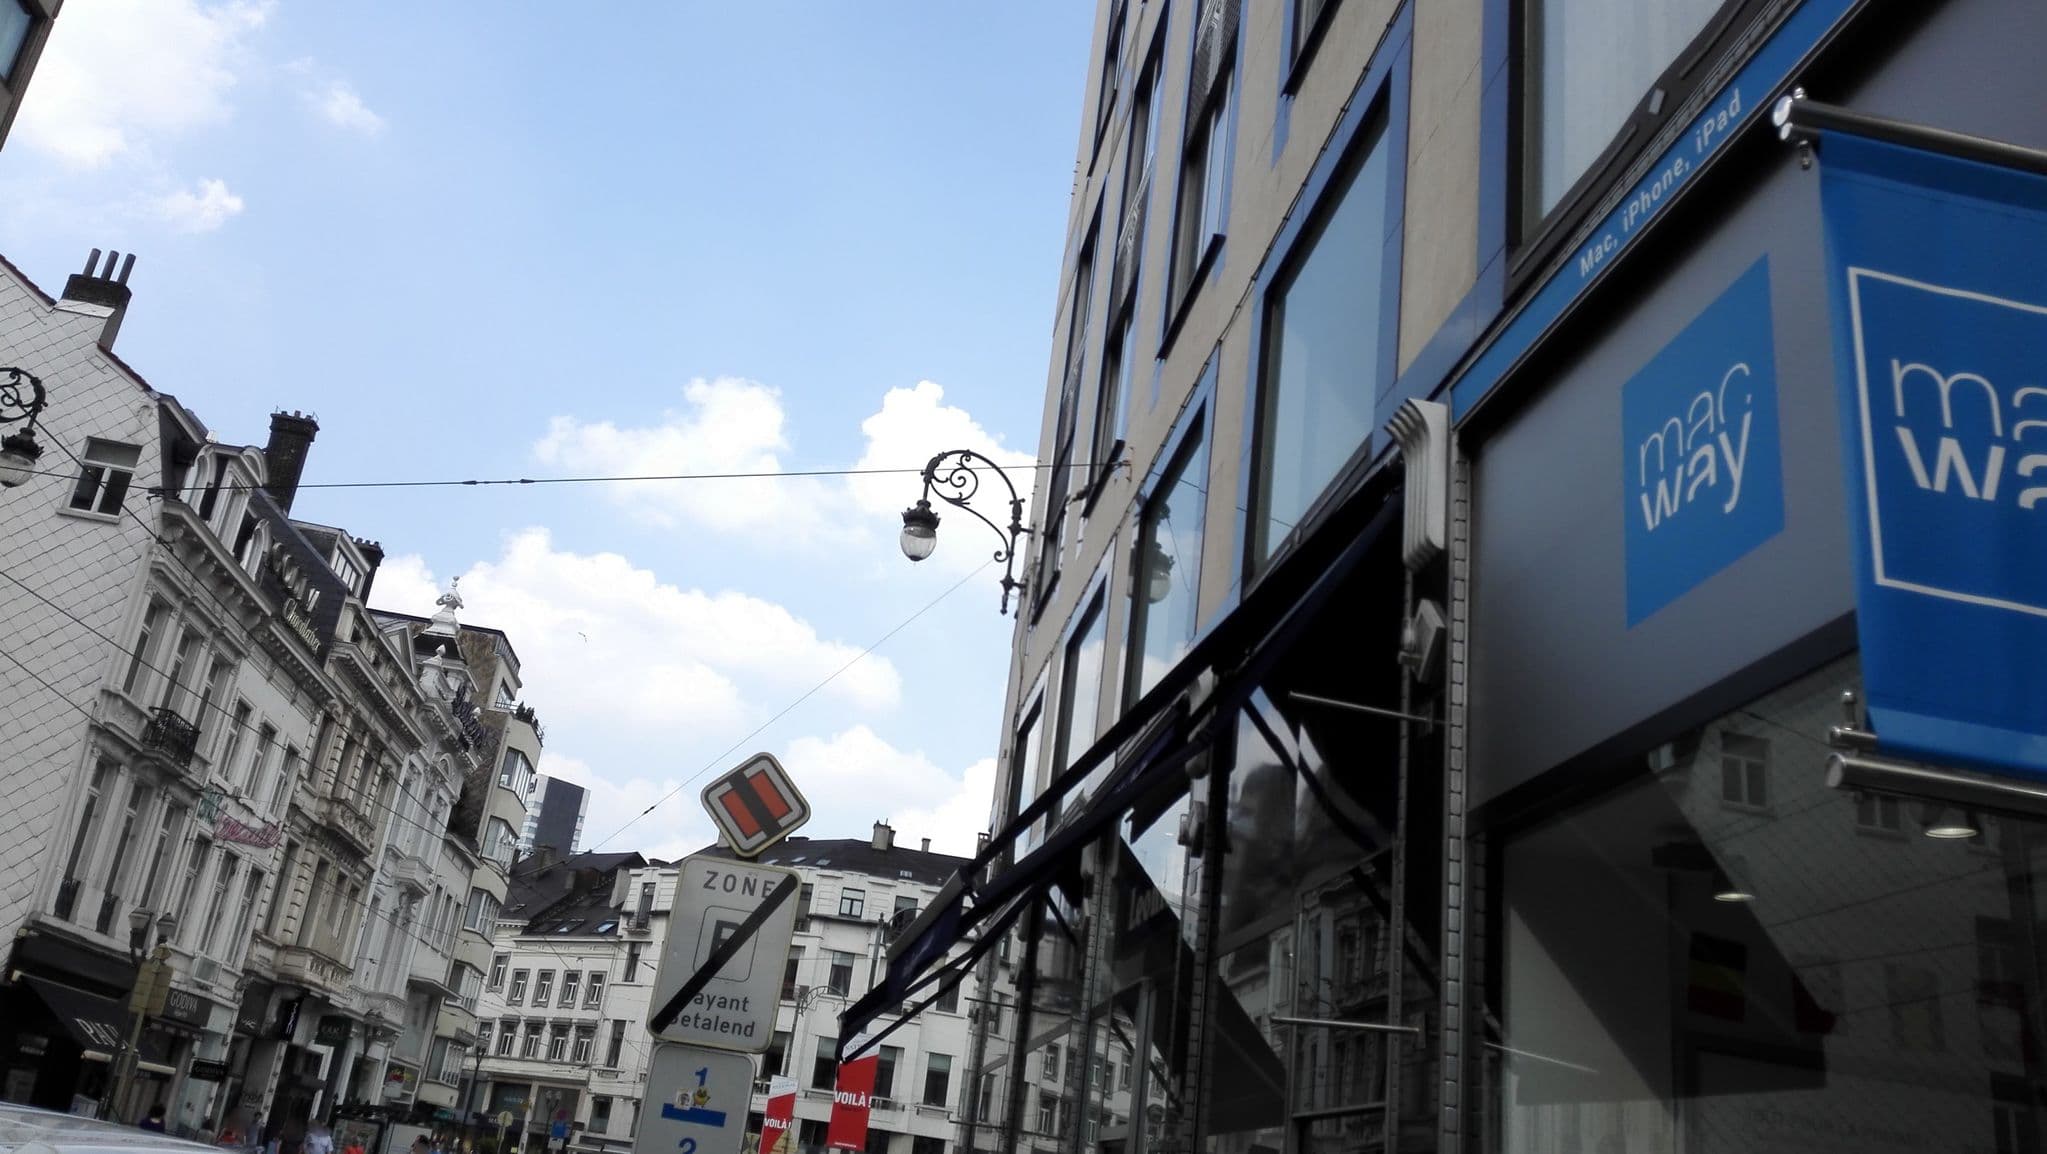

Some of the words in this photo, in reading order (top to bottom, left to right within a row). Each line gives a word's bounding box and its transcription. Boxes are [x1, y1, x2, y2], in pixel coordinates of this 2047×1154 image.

[1580, 233, 1618, 278] Mac,
[1622, 156, 1690, 234] iPhone,
[1695, 87, 1741, 154] iPad
[1640, 362, 1751, 487] mac
[1640, 411, 1752, 531] way
[703, 869, 776, 900] ZONE
[693, 991, 750, 1013] ayant
[695, 1066, 708, 1087] 1
[678, 1137, 697, 1154] 2
